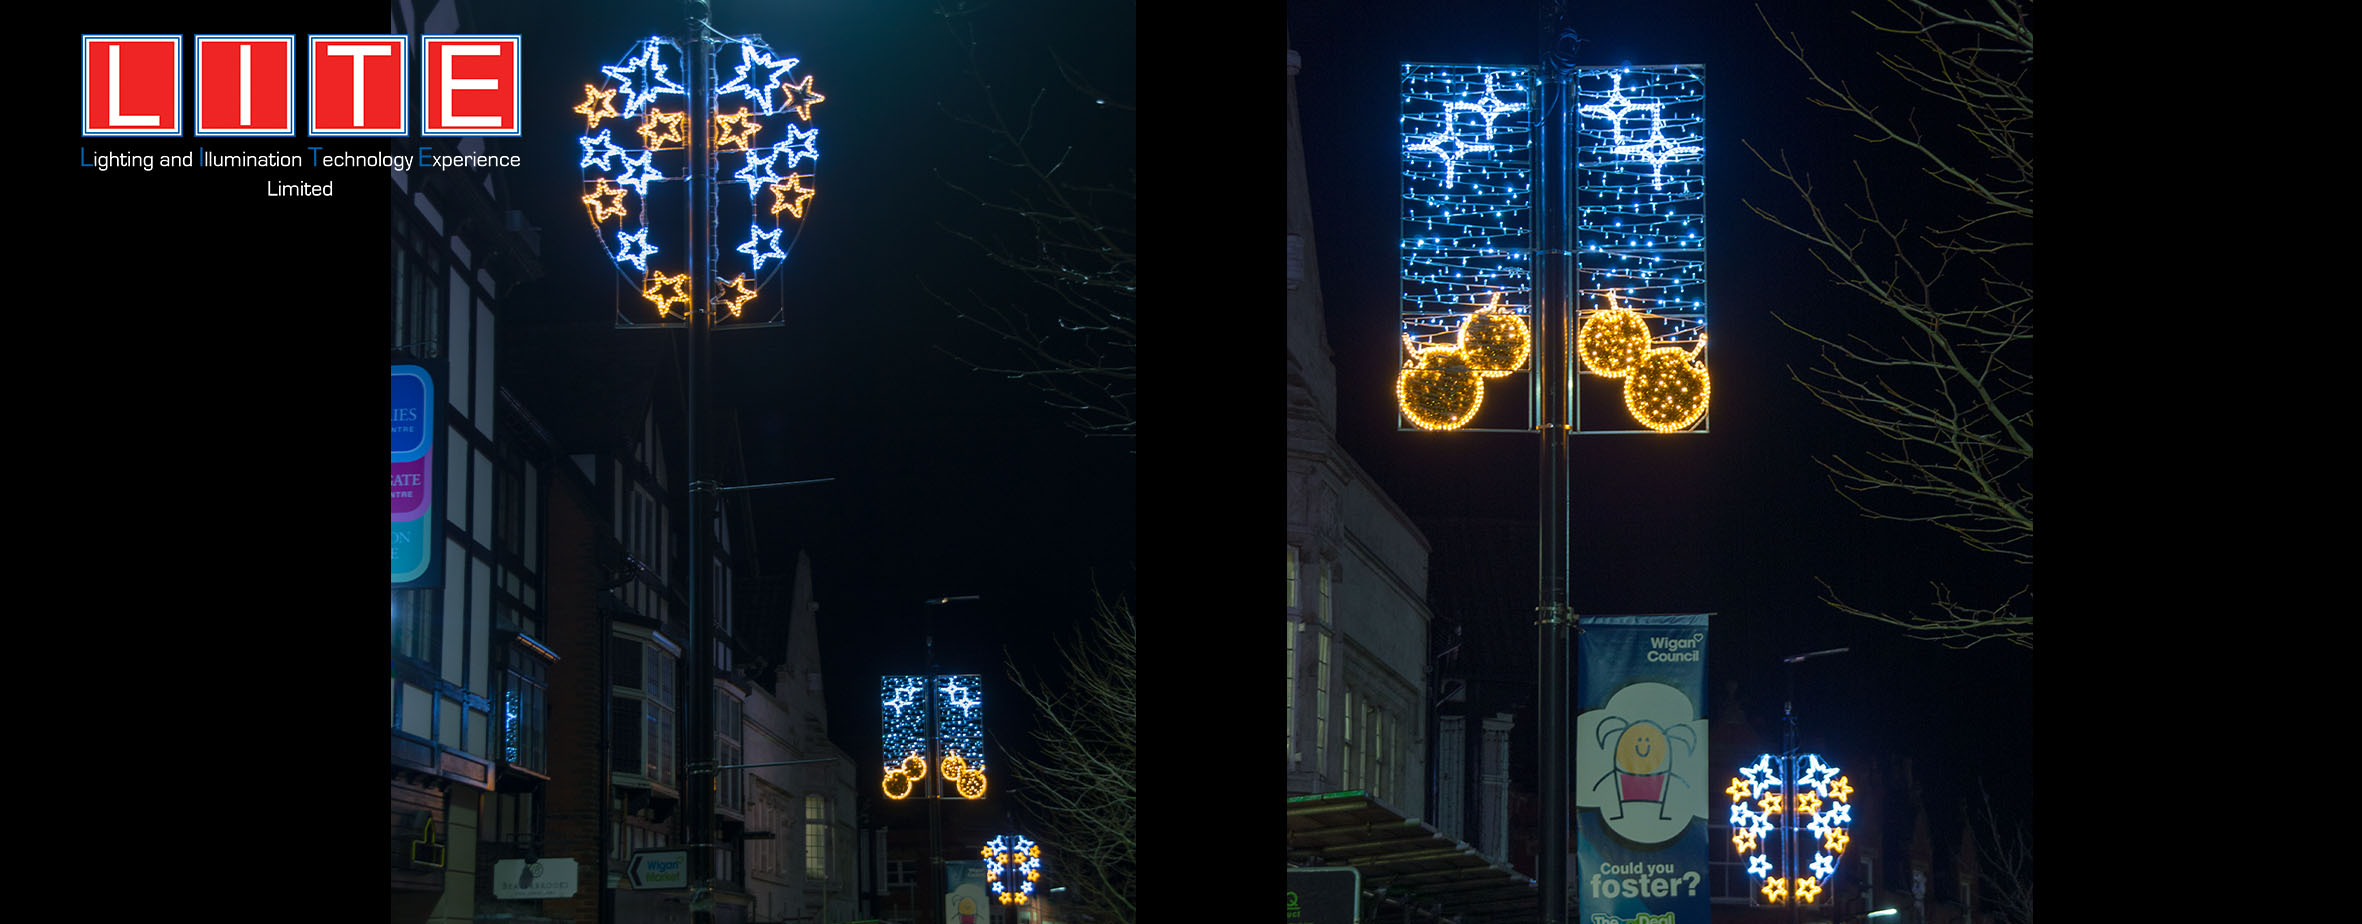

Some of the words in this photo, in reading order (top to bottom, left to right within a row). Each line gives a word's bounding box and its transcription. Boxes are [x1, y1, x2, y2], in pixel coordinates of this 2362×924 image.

[391, 408, 417, 422] IES
[1650, 637, 1696, 652] Wigan
[1647, 650, 1700, 662] Council
[647, 860, 679, 873] Wigan
[1600, 862, 1643, 875] Could
[1647, 864, 1674, 877] you
[1590, 871, 1701, 899] foster?
